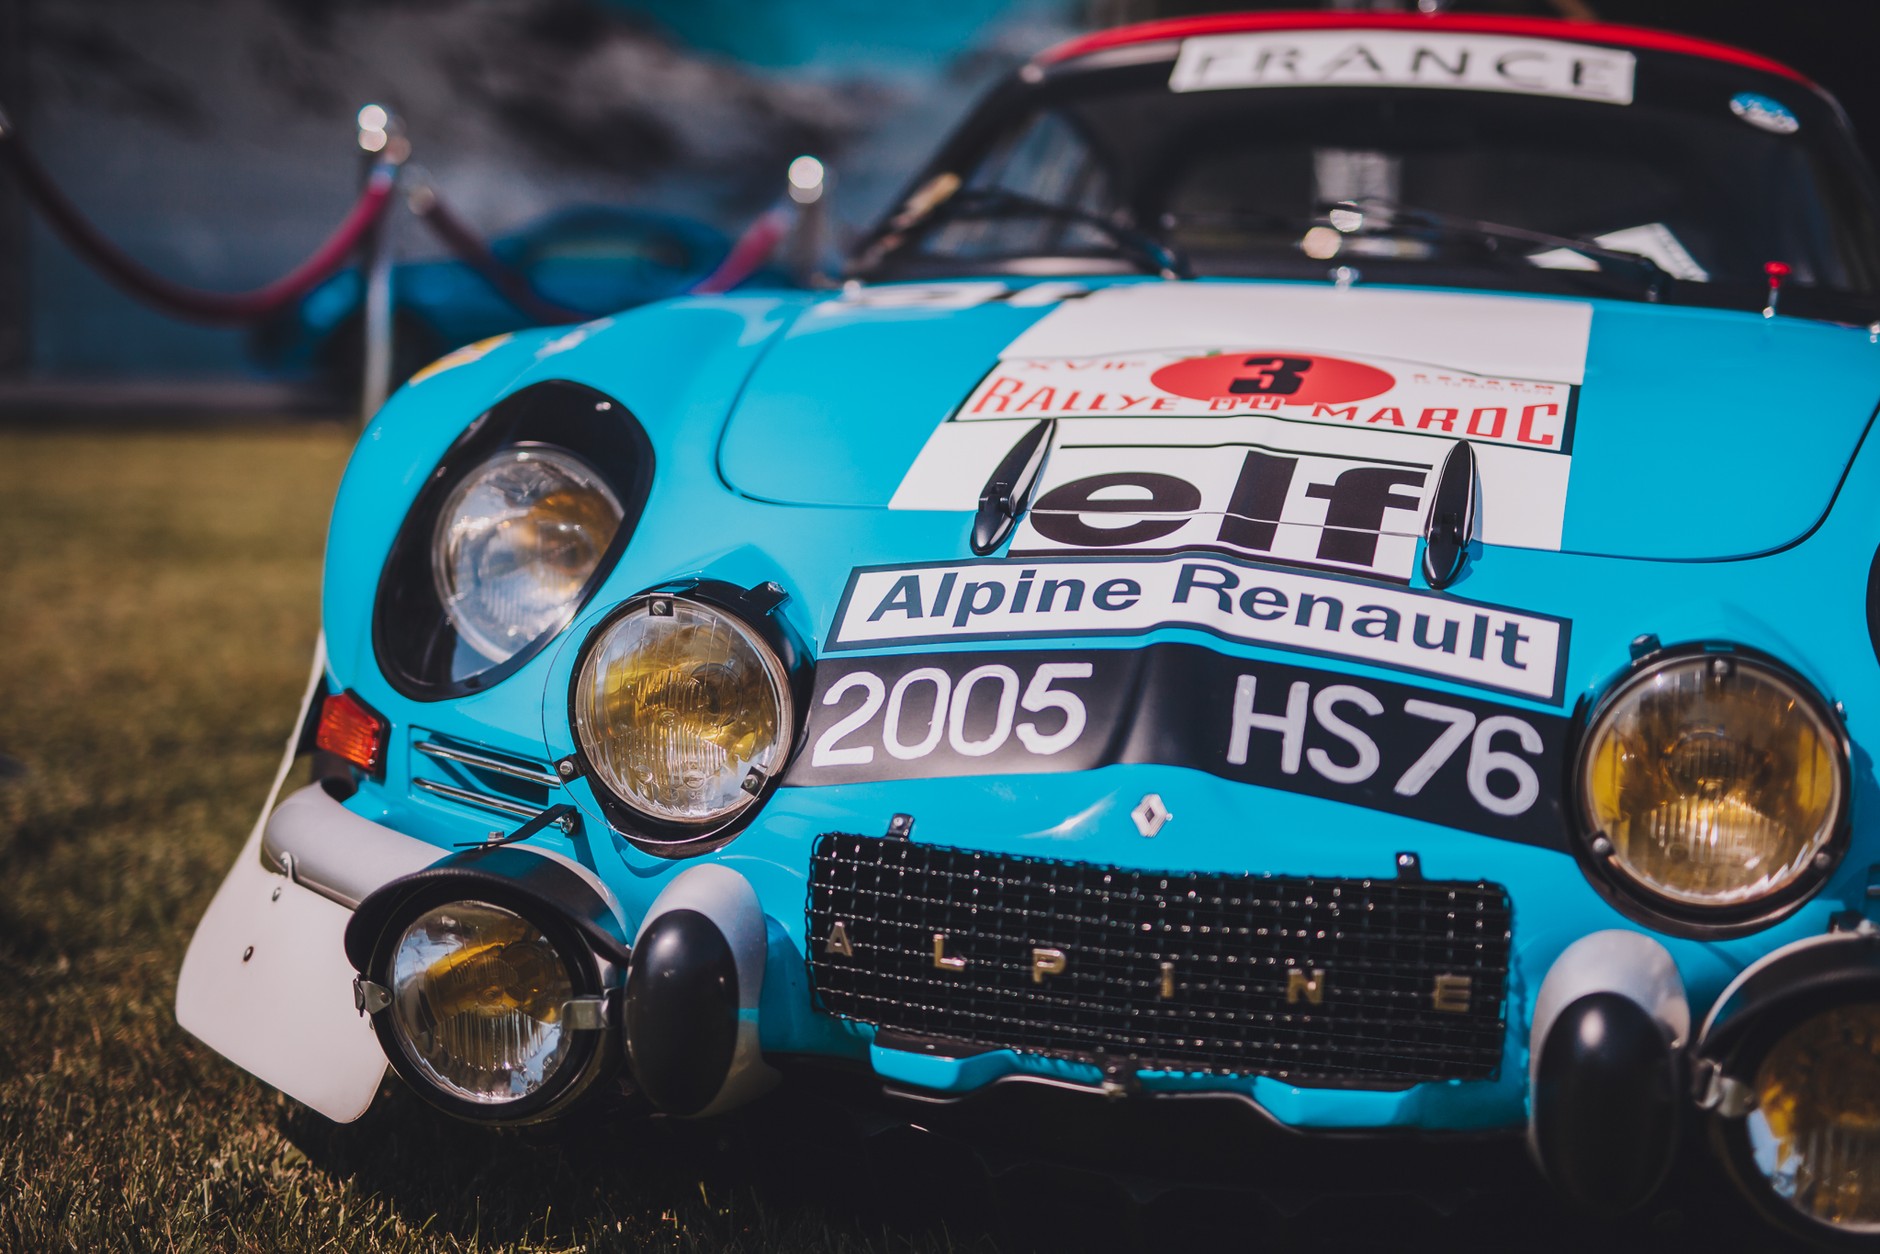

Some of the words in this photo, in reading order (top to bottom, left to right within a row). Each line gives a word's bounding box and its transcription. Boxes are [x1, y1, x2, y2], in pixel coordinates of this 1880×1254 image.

[1195, 42, 1620, 96] FRANCE
[970, 376, 1182, 414] RALLYE
[1311, 400, 1559, 445] MAROC
[1228, 356, 1314, 395] 3
[1029, 449, 1425, 568] elf
[866, 568, 1141, 629] Alpine
[1171, 562, 1531, 671] Renault
[811, 662, 1094, 768] 2005
